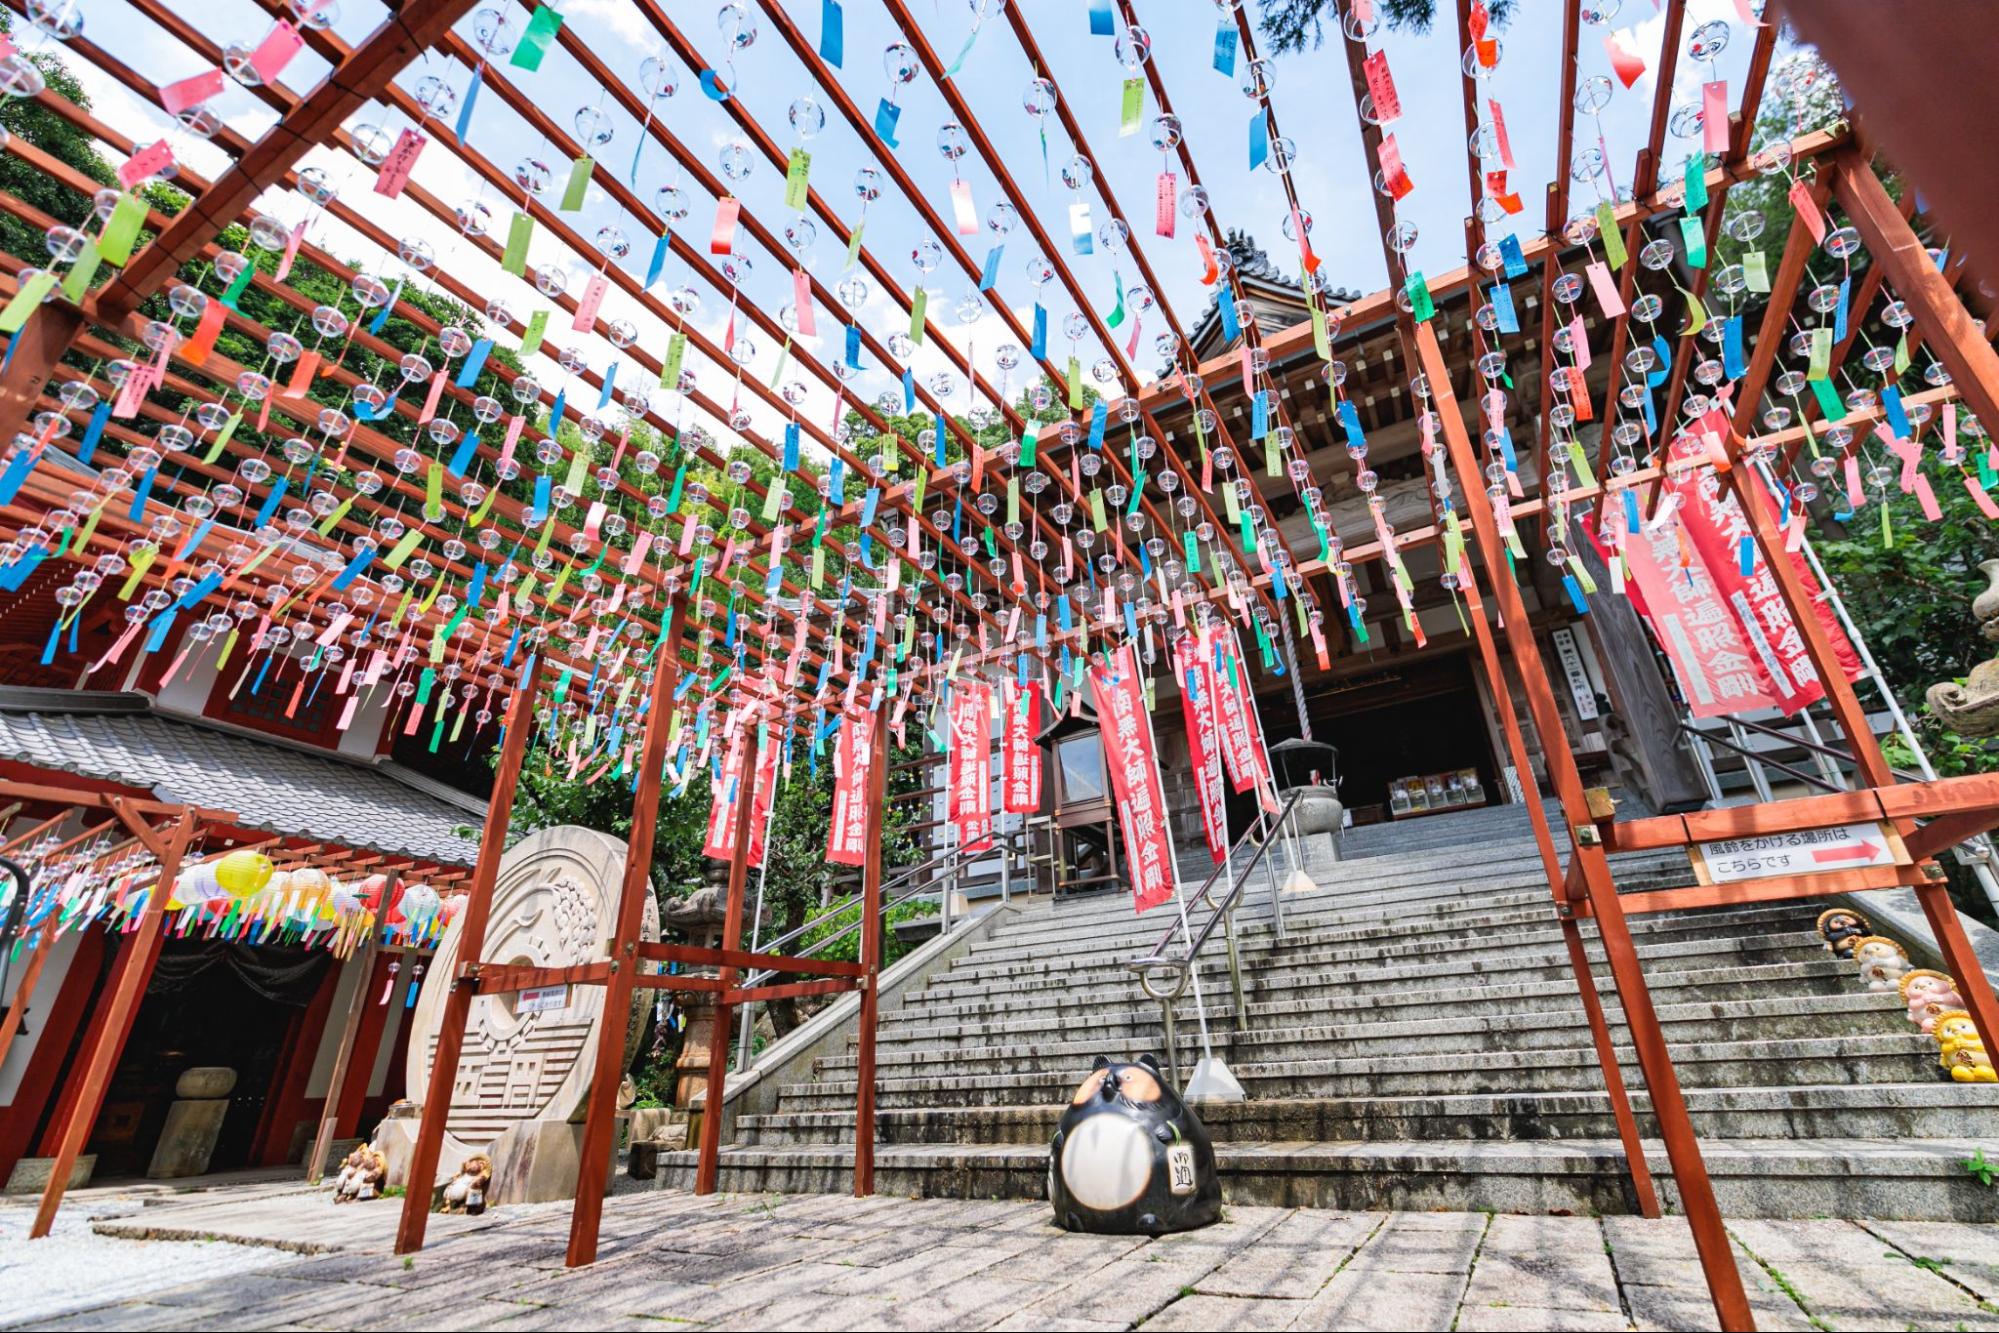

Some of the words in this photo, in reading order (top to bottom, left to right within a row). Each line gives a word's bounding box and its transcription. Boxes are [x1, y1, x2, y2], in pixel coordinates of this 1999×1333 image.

[1112, 687, 1163, 890] 南無大師遍照金剛
[1708, 827, 1852, 856] 風鈴をかける場所は
[1716, 854, 1792, 874] こちらです
